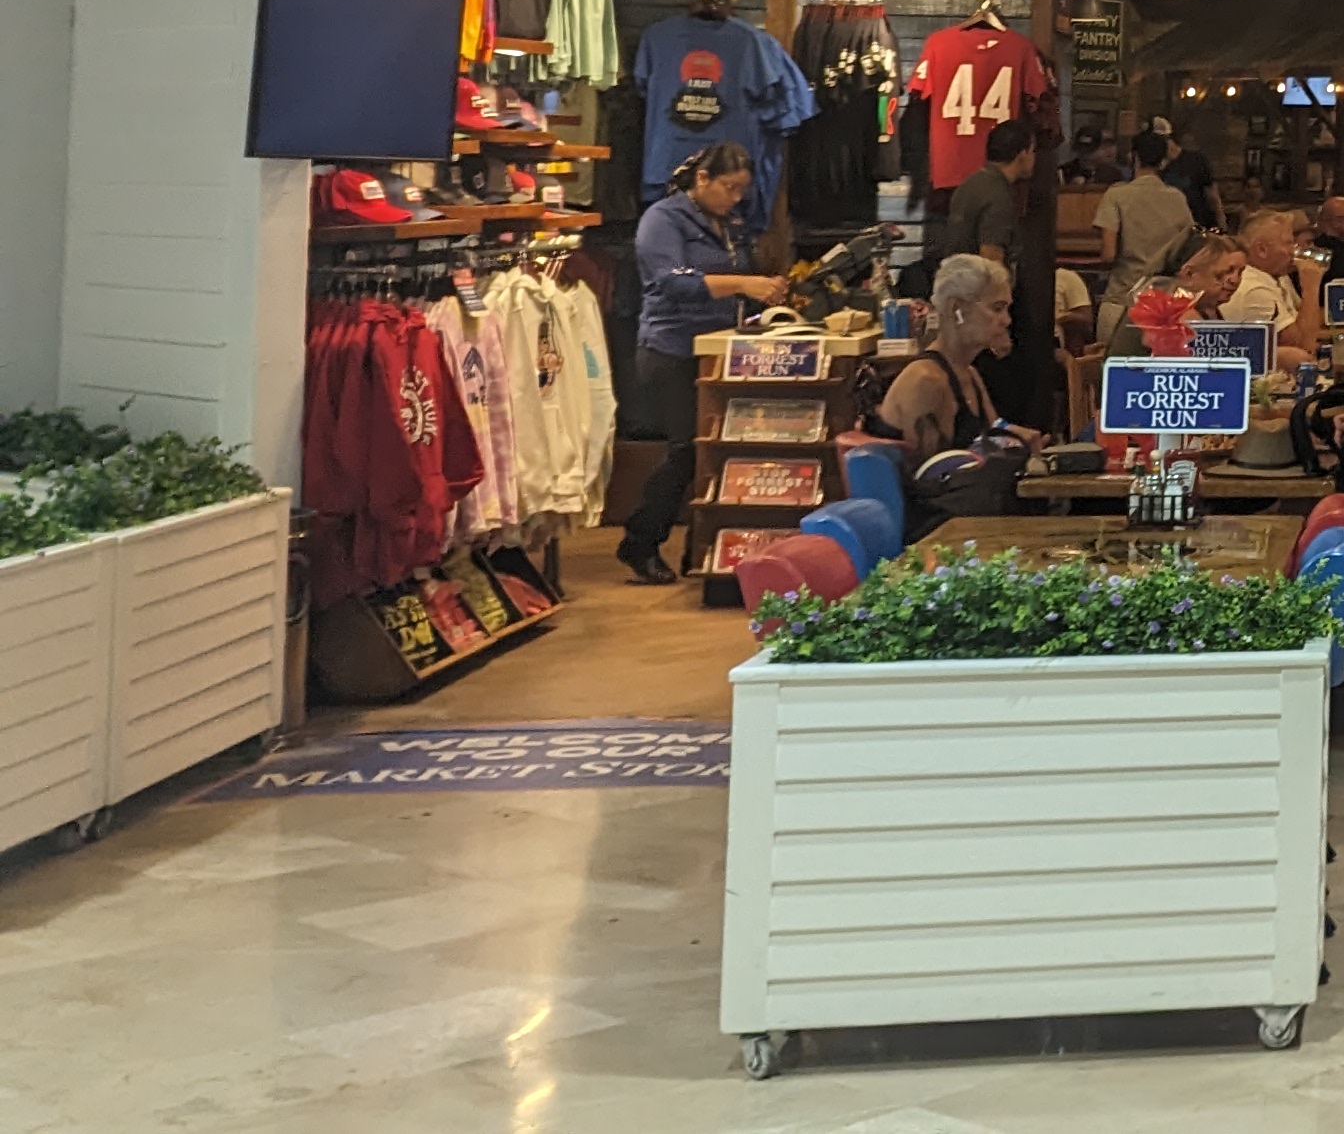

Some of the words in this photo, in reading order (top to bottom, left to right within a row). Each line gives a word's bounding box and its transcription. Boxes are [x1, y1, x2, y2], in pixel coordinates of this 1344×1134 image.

[941, 64, 1013, 135] 44
[1194, 333, 1230, 347] RUN
[742, 353, 809, 366] FORREST
[757, 365, 790, 377] RUN
[1153, 375, 1200, 392] RUN
[1125, 391, 1225, 410] FORREST
[1151, 409, 1198, 428] RUN
[428, 747, 529, 762] TO
[546, 745, 701, 758] OUR
[252, 762, 556, 788] MARKET
[563, 760, 731, 778] STOR
